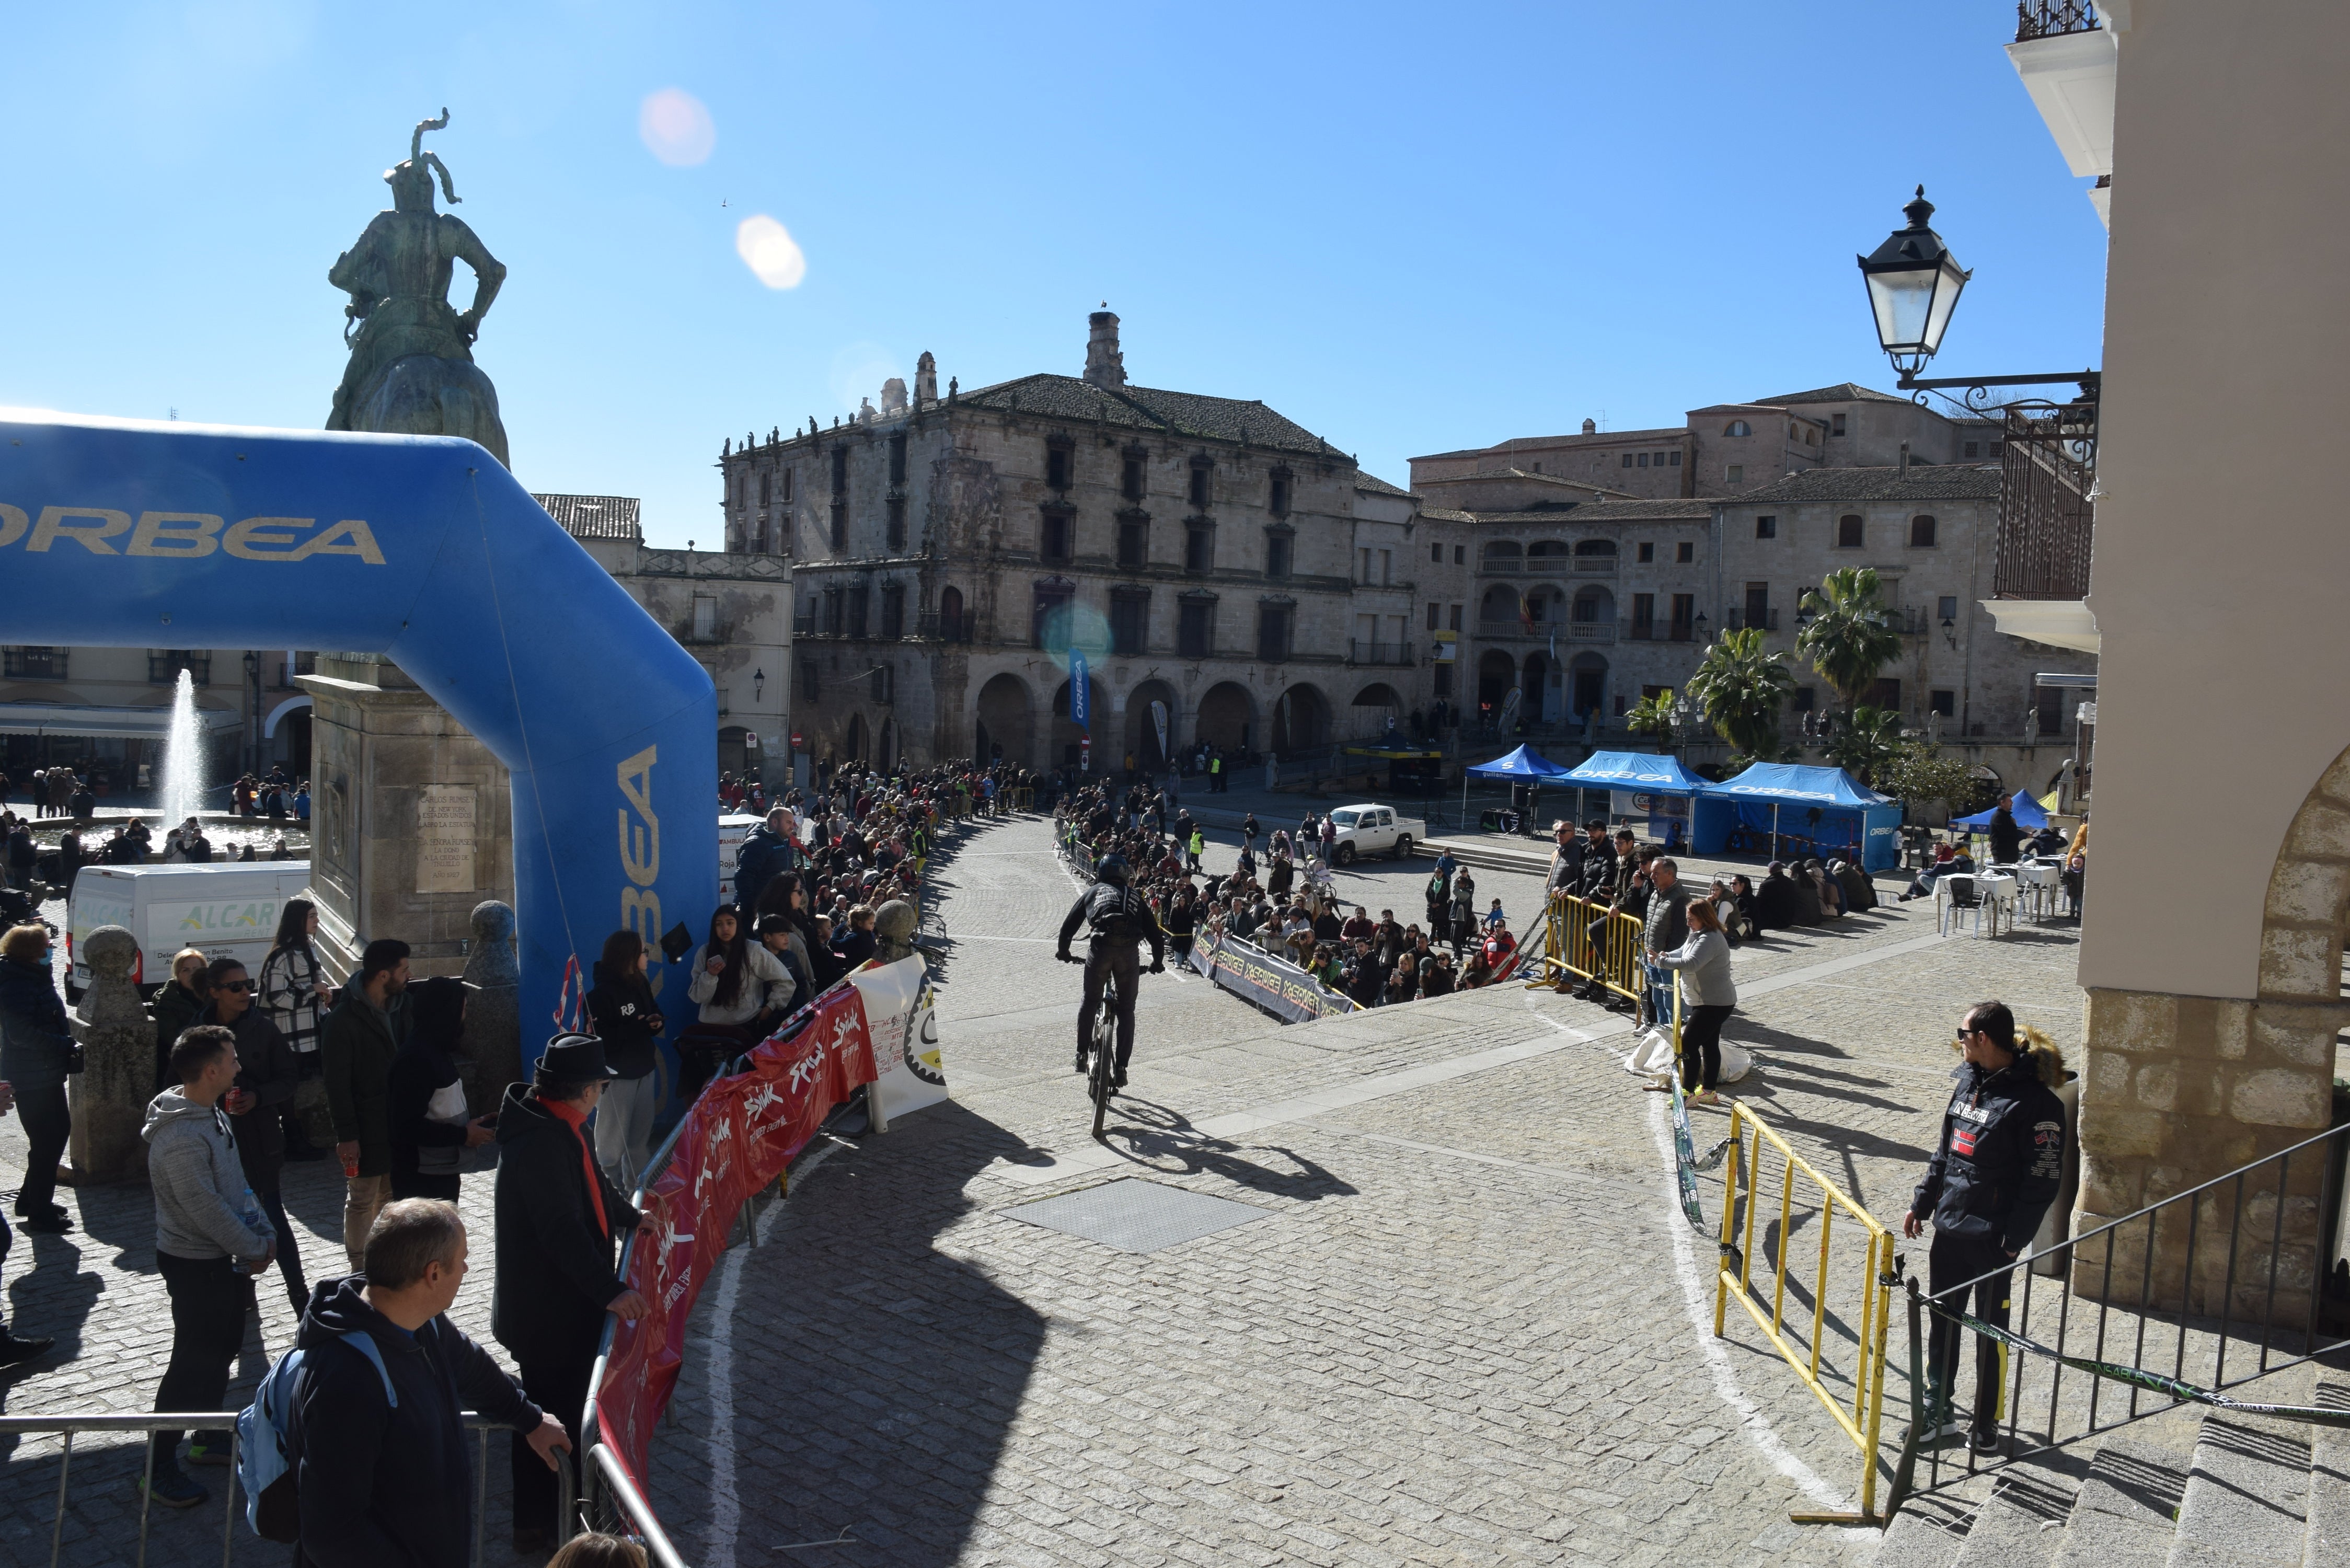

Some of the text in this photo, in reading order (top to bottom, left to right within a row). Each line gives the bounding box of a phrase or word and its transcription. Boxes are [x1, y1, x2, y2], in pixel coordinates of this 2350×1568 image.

[0, 503, 386, 564] RBEA
[1571, 770, 1672, 782] ORBEA
[1730, 786, 1836, 800] ORBEA
[1870, 827, 1893, 836] ORBEA
[179, 903, 275, 930] ALCAR
[244, 928, 271, 938] RENT
[620, 1003, 635, 1016] RB
[892, 1032, 903, 1040] MTB
[744, 1082, 783, 1129] Spiuk
[1955, 1102, 1986, 1122] NORWAY
[1961, 1314, 2010, 1343] SOMOS DEPORTE
[2213, 1401, 2276, 1413] EXTREMADURA
